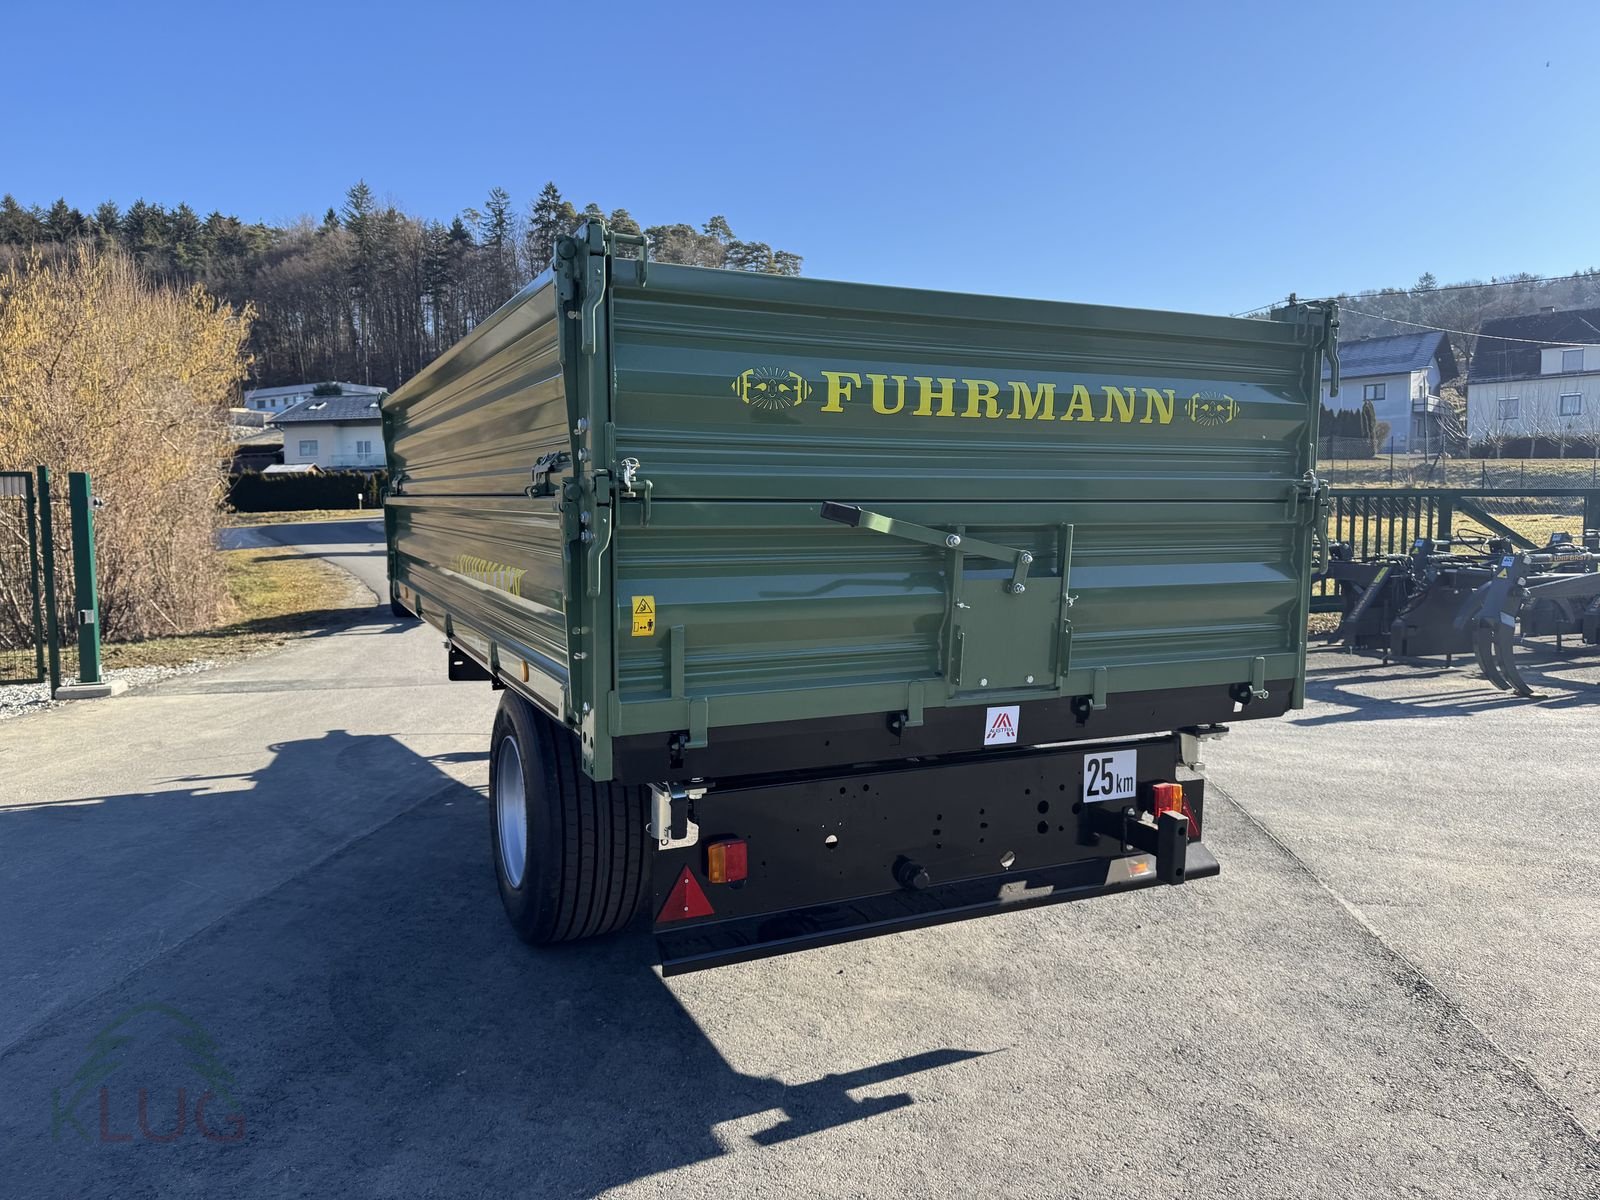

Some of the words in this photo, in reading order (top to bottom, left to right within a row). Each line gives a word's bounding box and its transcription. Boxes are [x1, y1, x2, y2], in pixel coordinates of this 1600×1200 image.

[820, 370, 1175, 424] FUHRMANN
[1086, 757, 1113, 796] 25
[1116, 773, 1133, 793] km
